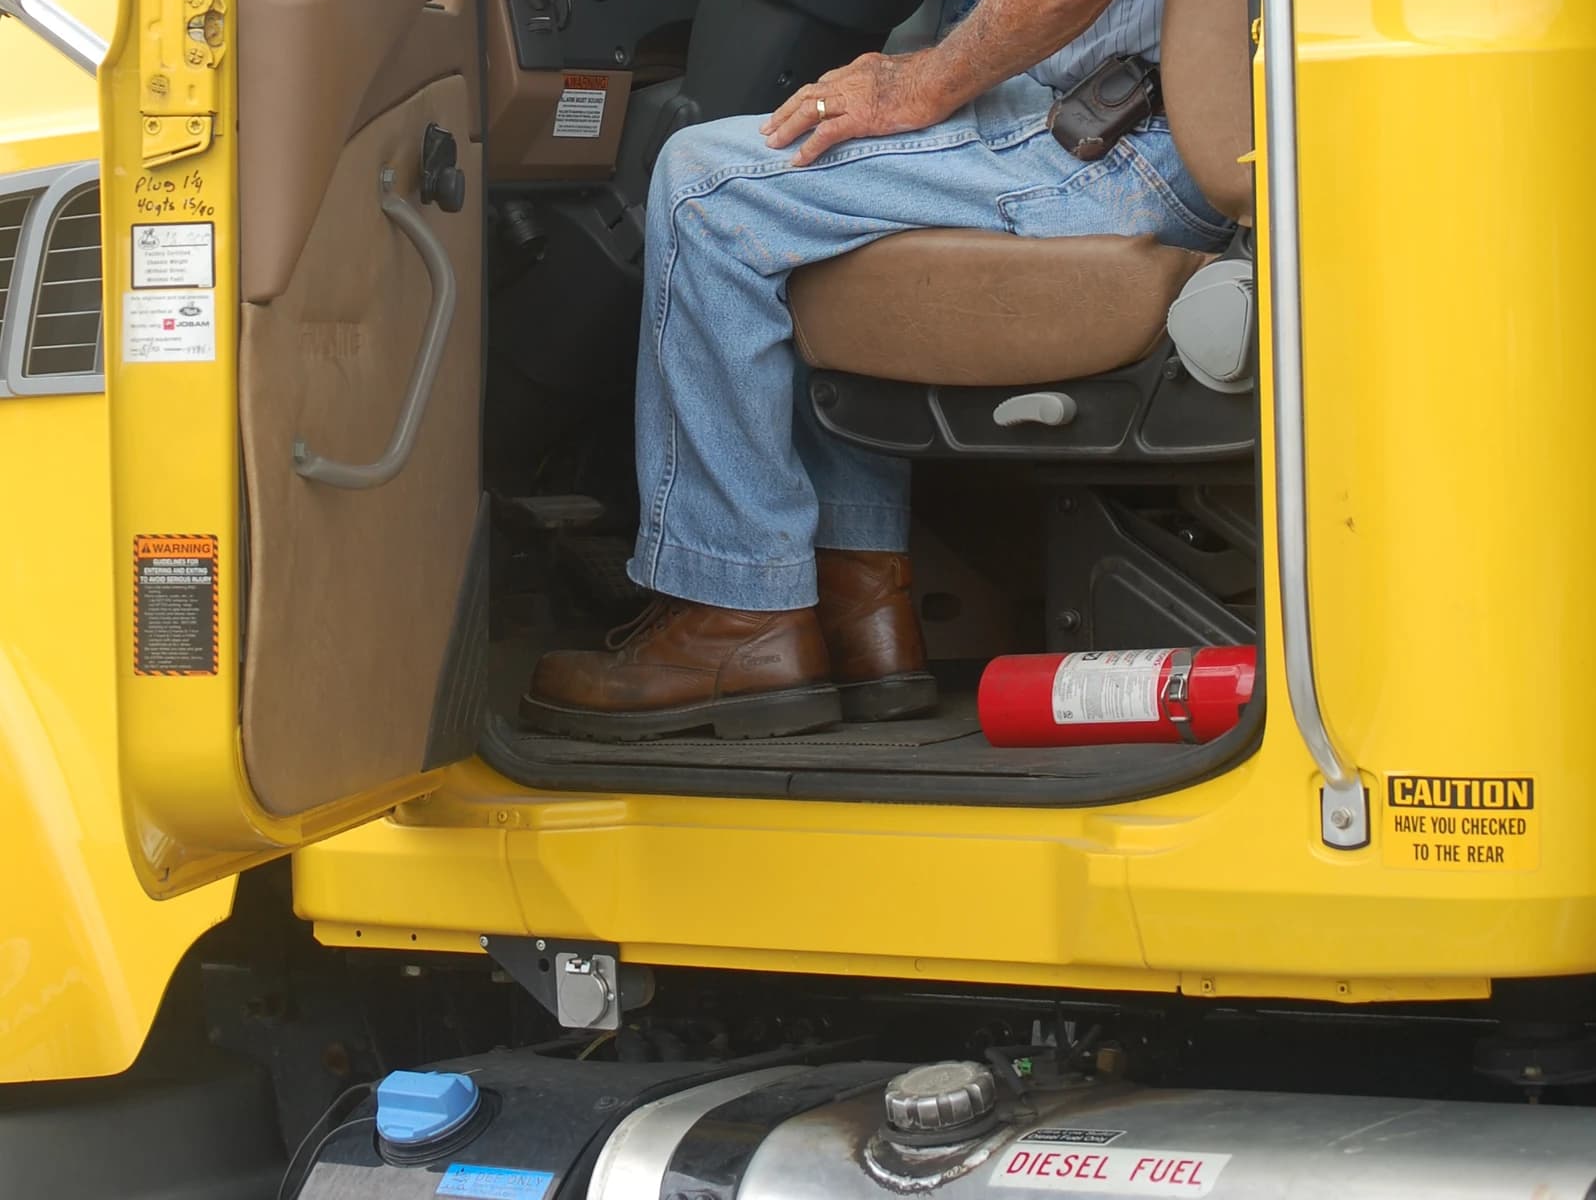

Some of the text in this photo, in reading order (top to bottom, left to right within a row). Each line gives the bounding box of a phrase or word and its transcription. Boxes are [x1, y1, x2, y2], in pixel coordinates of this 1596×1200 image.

[153, 543, 210, 553] WARNING
[1393, 778, 1528, 808] CAUTION
[1394, 815, 1526, 835] HAVE YOU CHECKED
[1413, 843, 1504, 863] TO THE REAR
[1006, 1151, 1203, 1185] DIESEL FUEL
